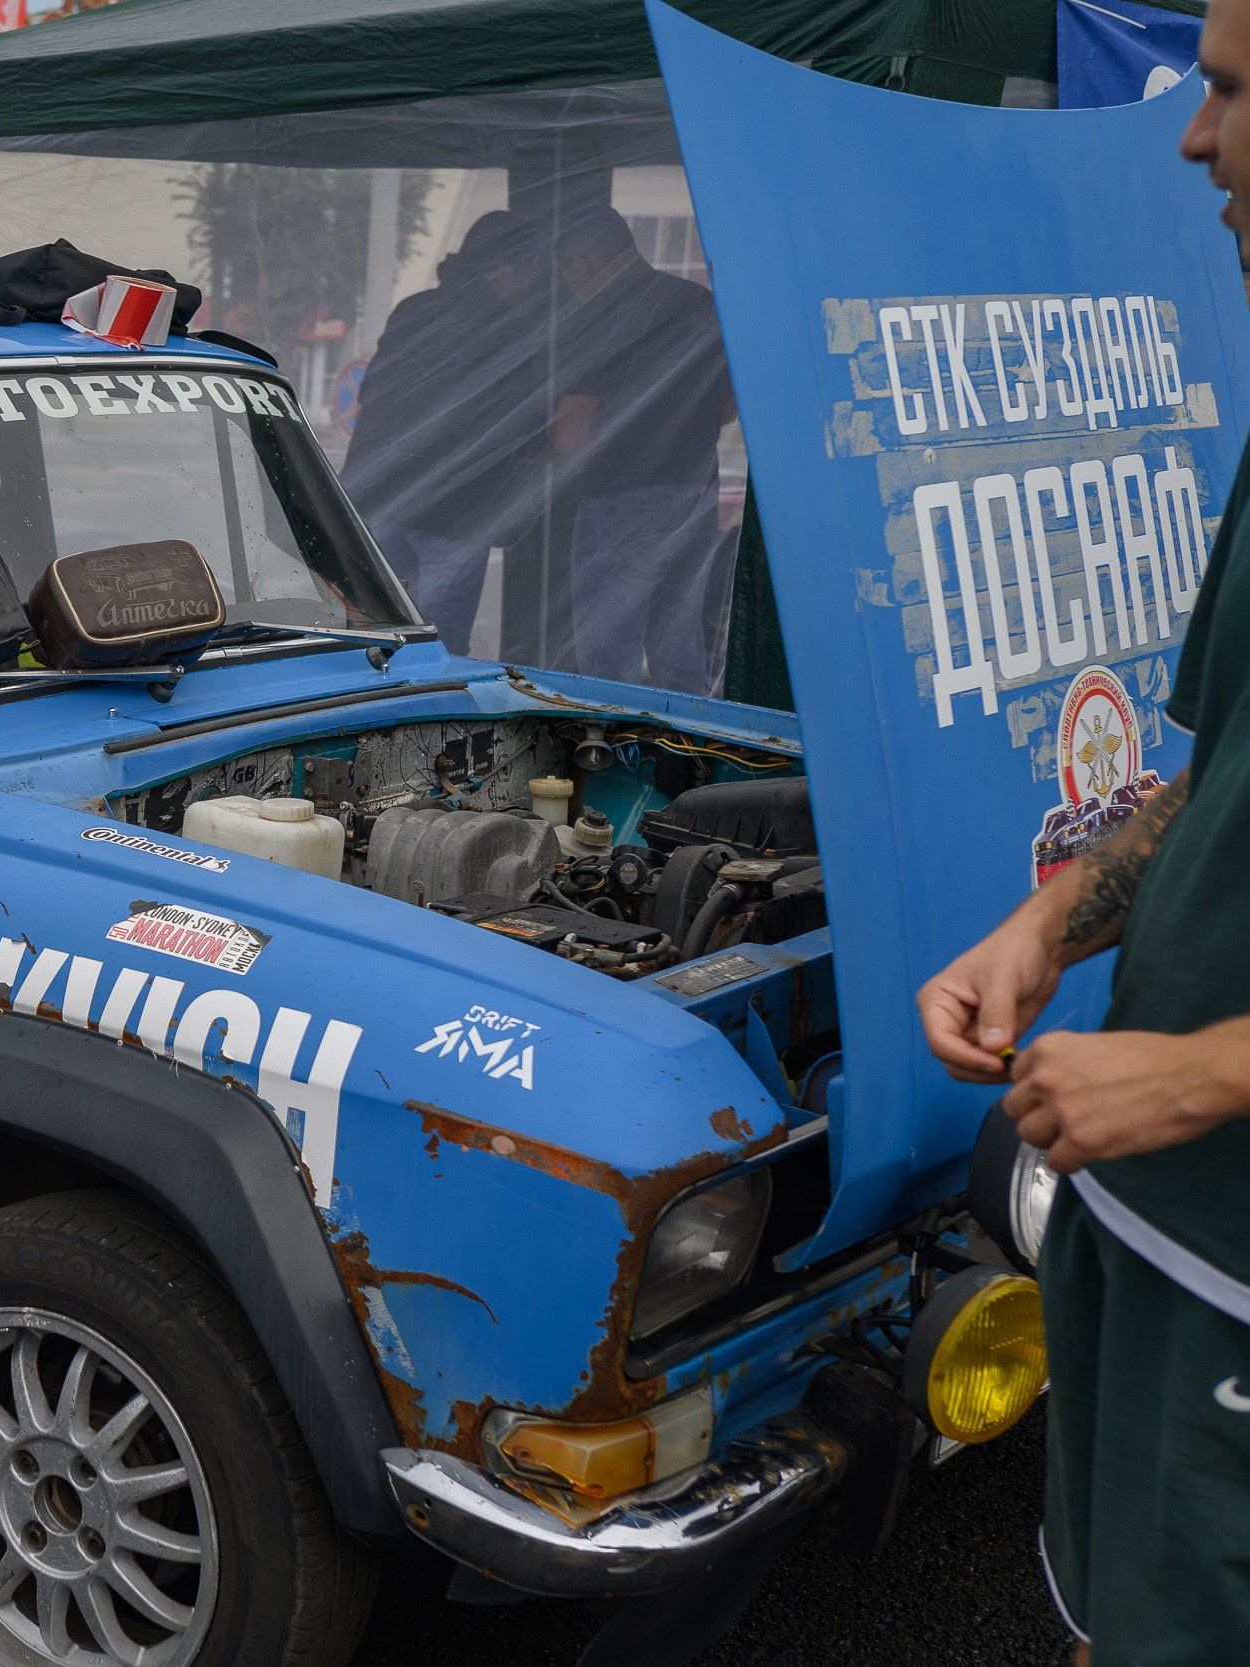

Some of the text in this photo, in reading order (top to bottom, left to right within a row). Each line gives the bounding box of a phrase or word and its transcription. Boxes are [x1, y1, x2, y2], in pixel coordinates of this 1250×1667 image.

[879, 296, 1183, 436] СТК СУЗДАЛЬ
[913, 446, 1207, 728] ДОСААФ
[82, 828, 212, 868] Continental
[126, 918, 230, 964] MARATHON
[464, 1004, 542, 1039] DRIFT
